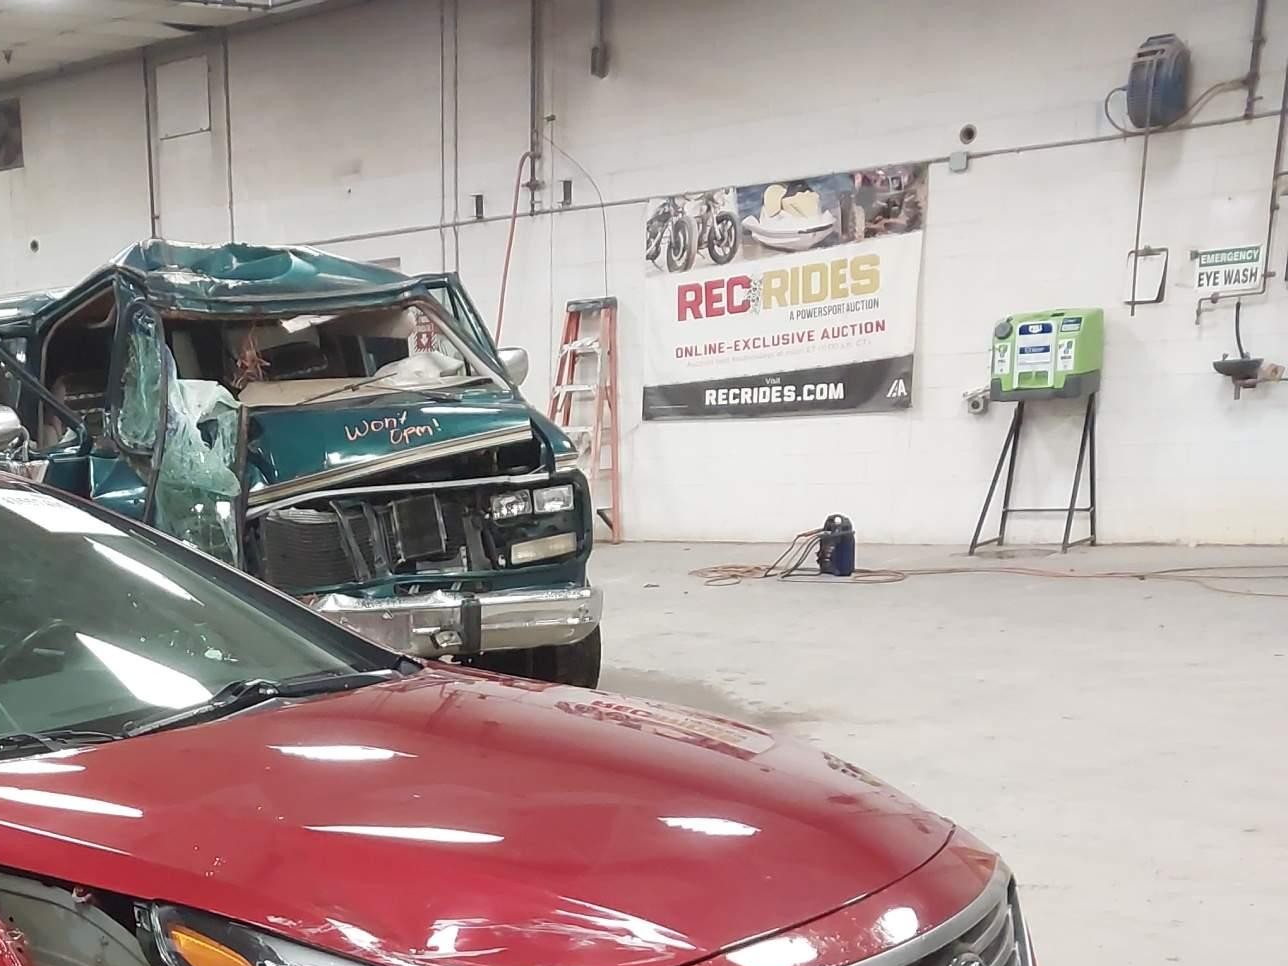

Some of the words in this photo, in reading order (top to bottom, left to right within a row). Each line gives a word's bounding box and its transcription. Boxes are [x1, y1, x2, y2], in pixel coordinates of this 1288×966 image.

[1200, 249, 1259, 265] EMERGENCY
[761, 254, 880, 309] RIDES
[1198, 270, 1220, 288] EYE
[1223, 267, 1258, 286] WASH
[796, 303, 845, 320] POWERSPORT
[846, 298, 880, 313] AUCTION
[675, 329, 816, 359] ONLINE-EXCLUSIVE
[820, 319, 886, 340] AUCTION
[705, 383, 845, 406] RECRIDES.COM
